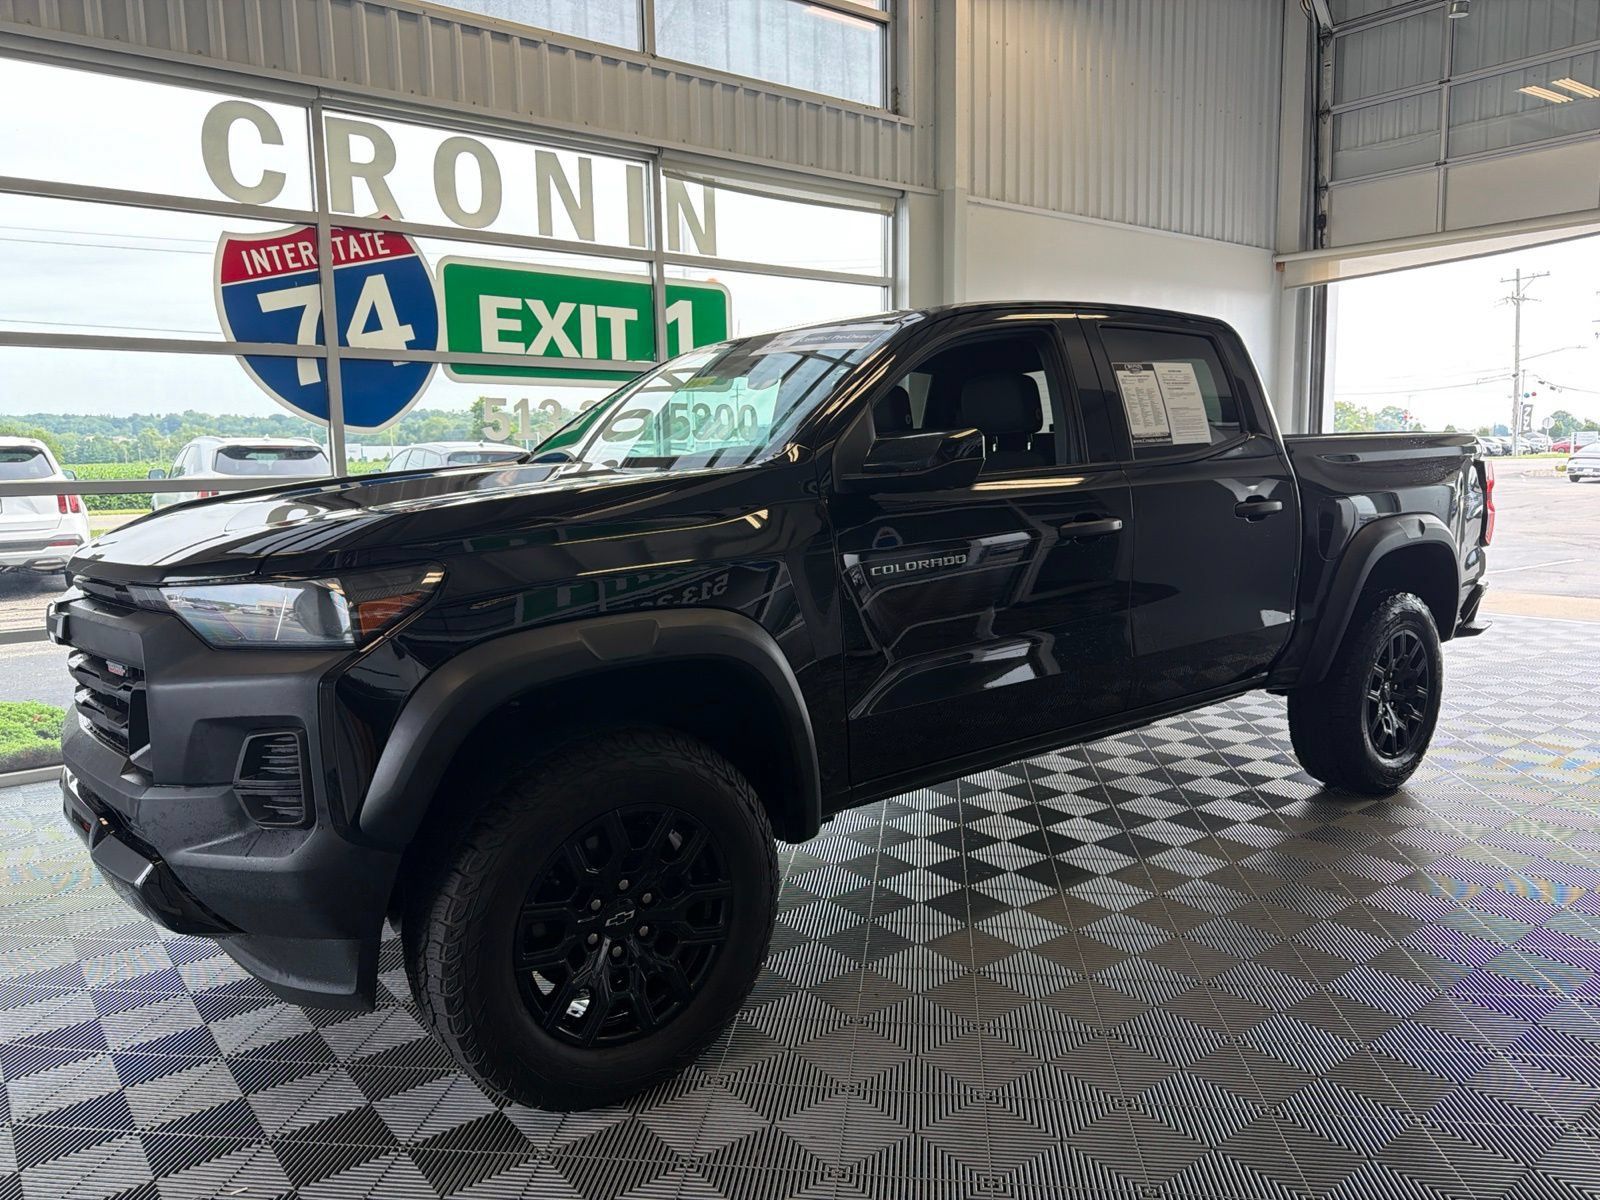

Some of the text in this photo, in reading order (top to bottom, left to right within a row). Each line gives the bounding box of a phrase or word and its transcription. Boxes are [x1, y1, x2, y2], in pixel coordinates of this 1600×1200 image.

[201, 100, 718, 256] CRONIN
[241, 231, 391, 276] INTERTATE
[257, 273, 415, 386] 74
[479, 294, 694, 361] EXIT 1
[870, 555, 967, 576] COLORADO
